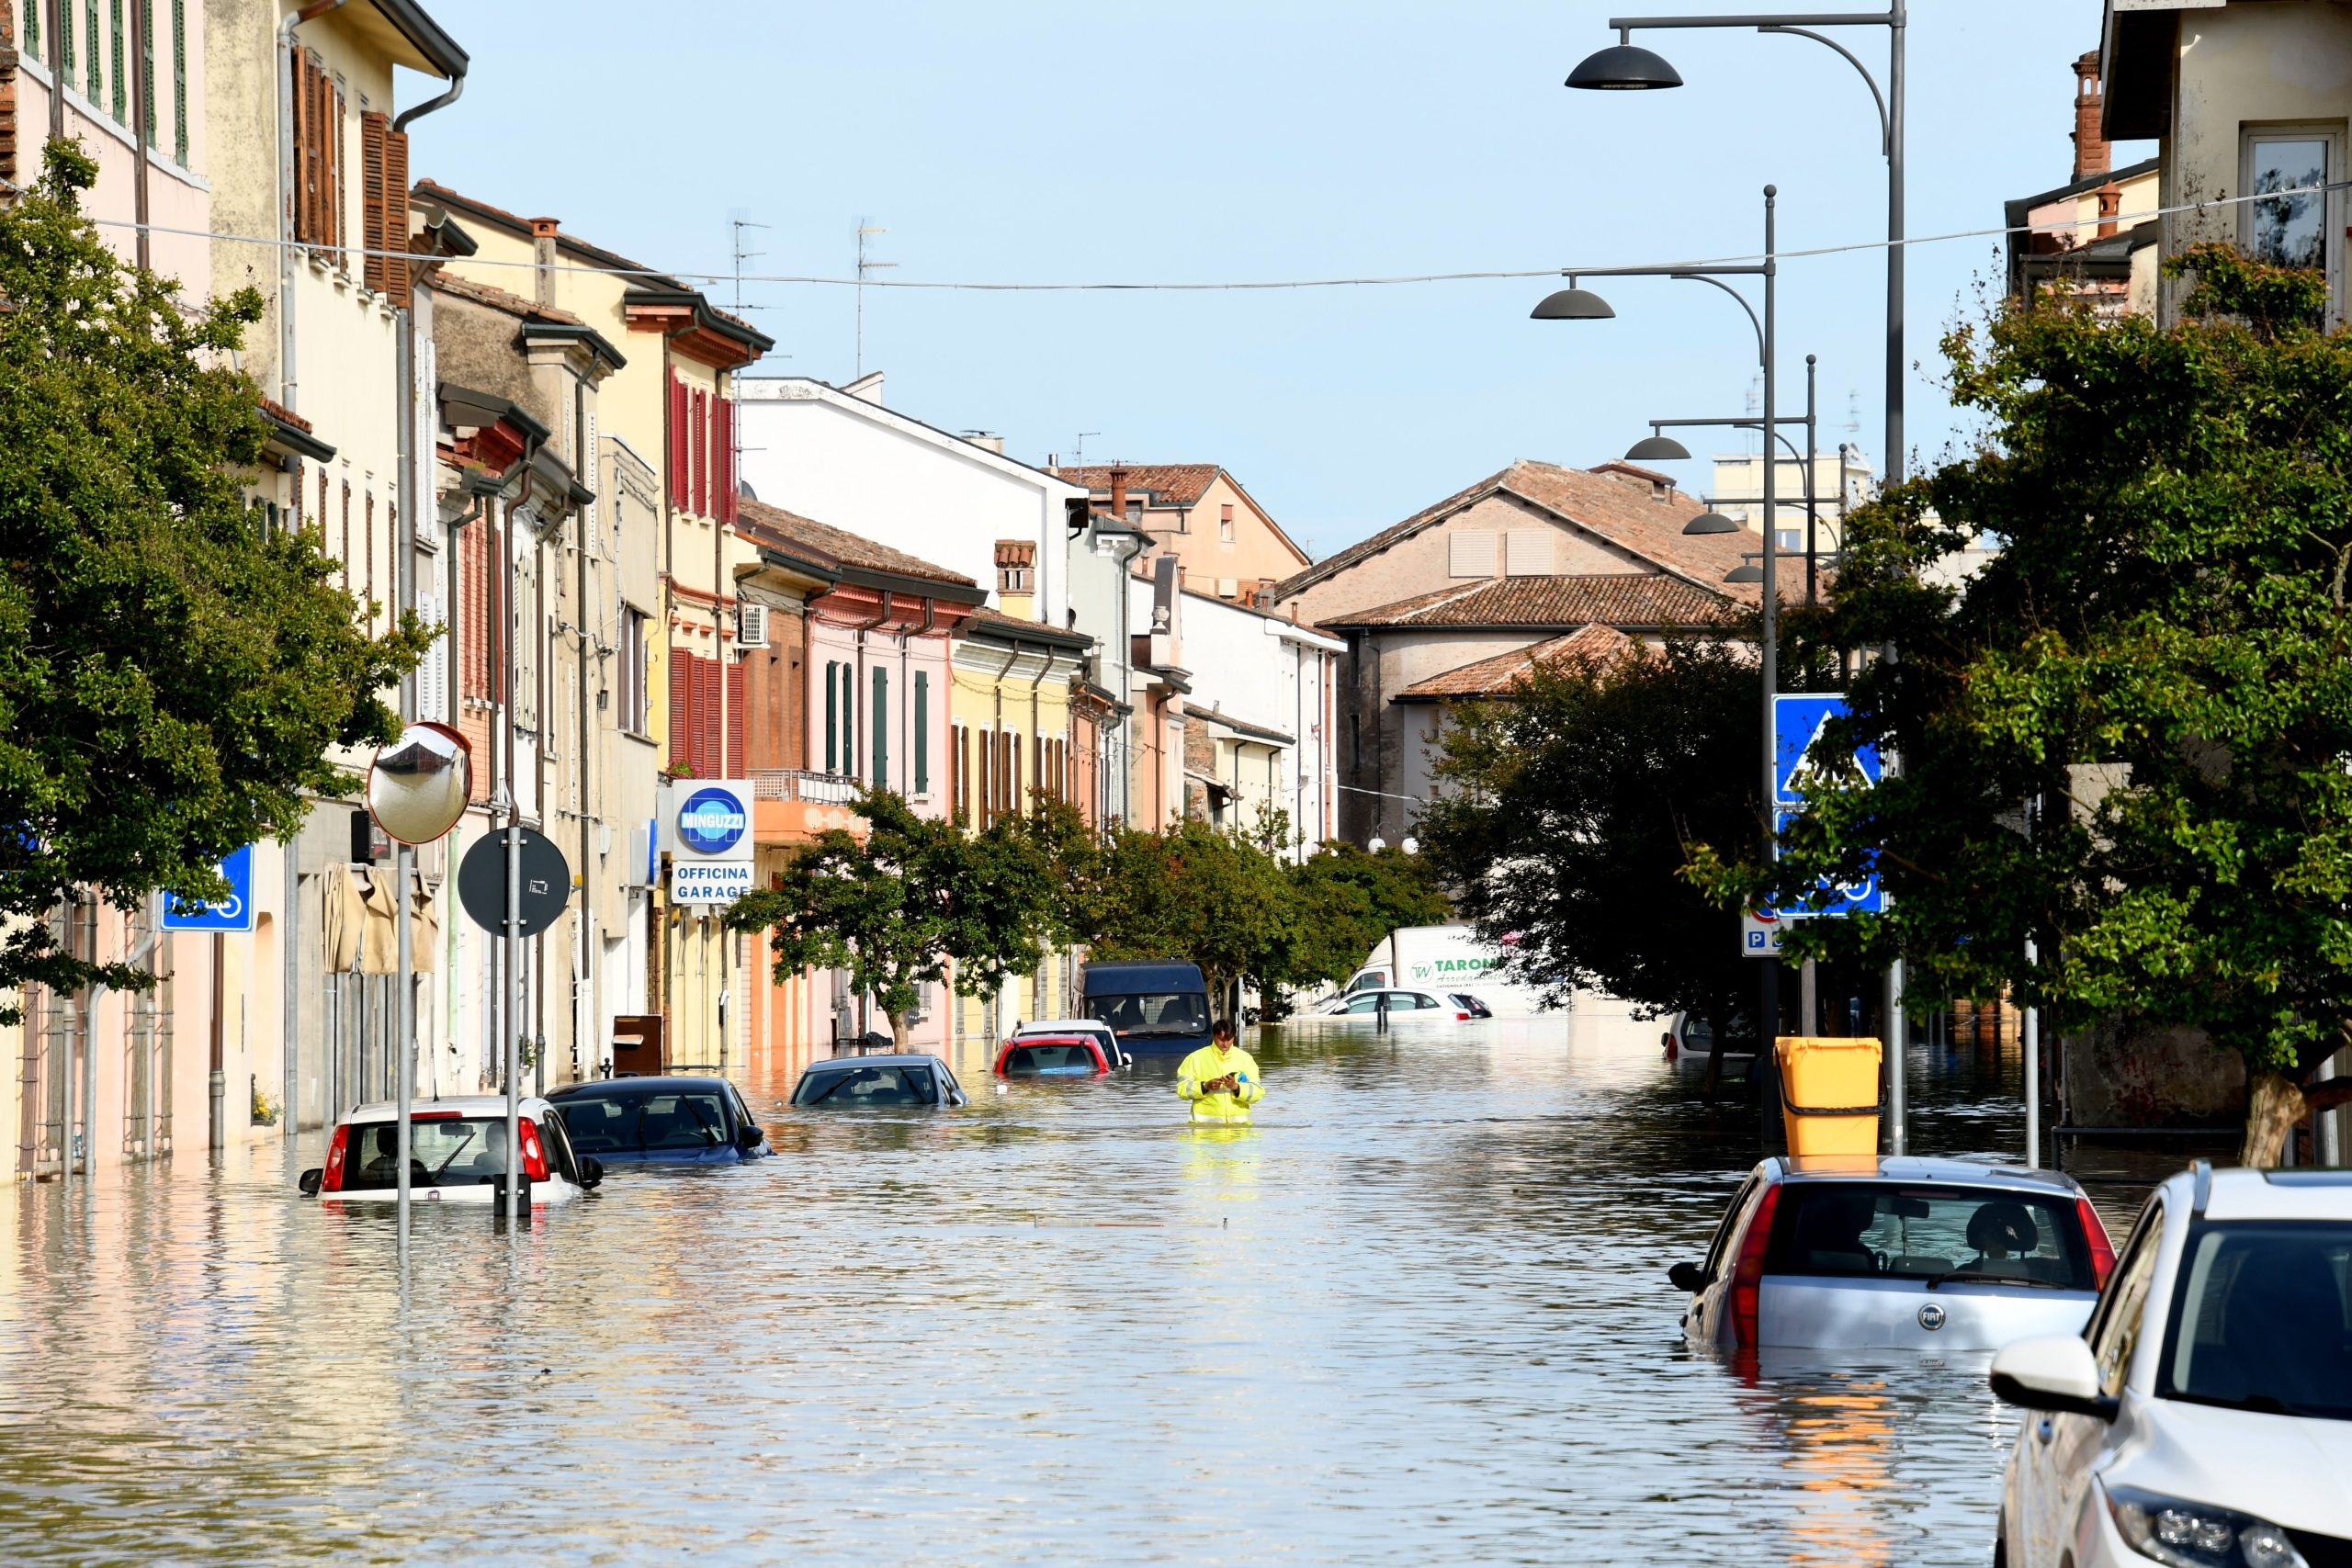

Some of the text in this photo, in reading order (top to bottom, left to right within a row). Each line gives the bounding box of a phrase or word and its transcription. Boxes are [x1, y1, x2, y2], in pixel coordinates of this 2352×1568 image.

[683, 813, 743, 829] MINGUZZI
[678, 867, 748, 879] OFFICINA
[678, 886, 748, 898] GARAGE
[1752, 932, 1762, 946] P
[1435, 958, 1501, 972] TARON
[1922, 1312, 1940, 1322] FIAT
